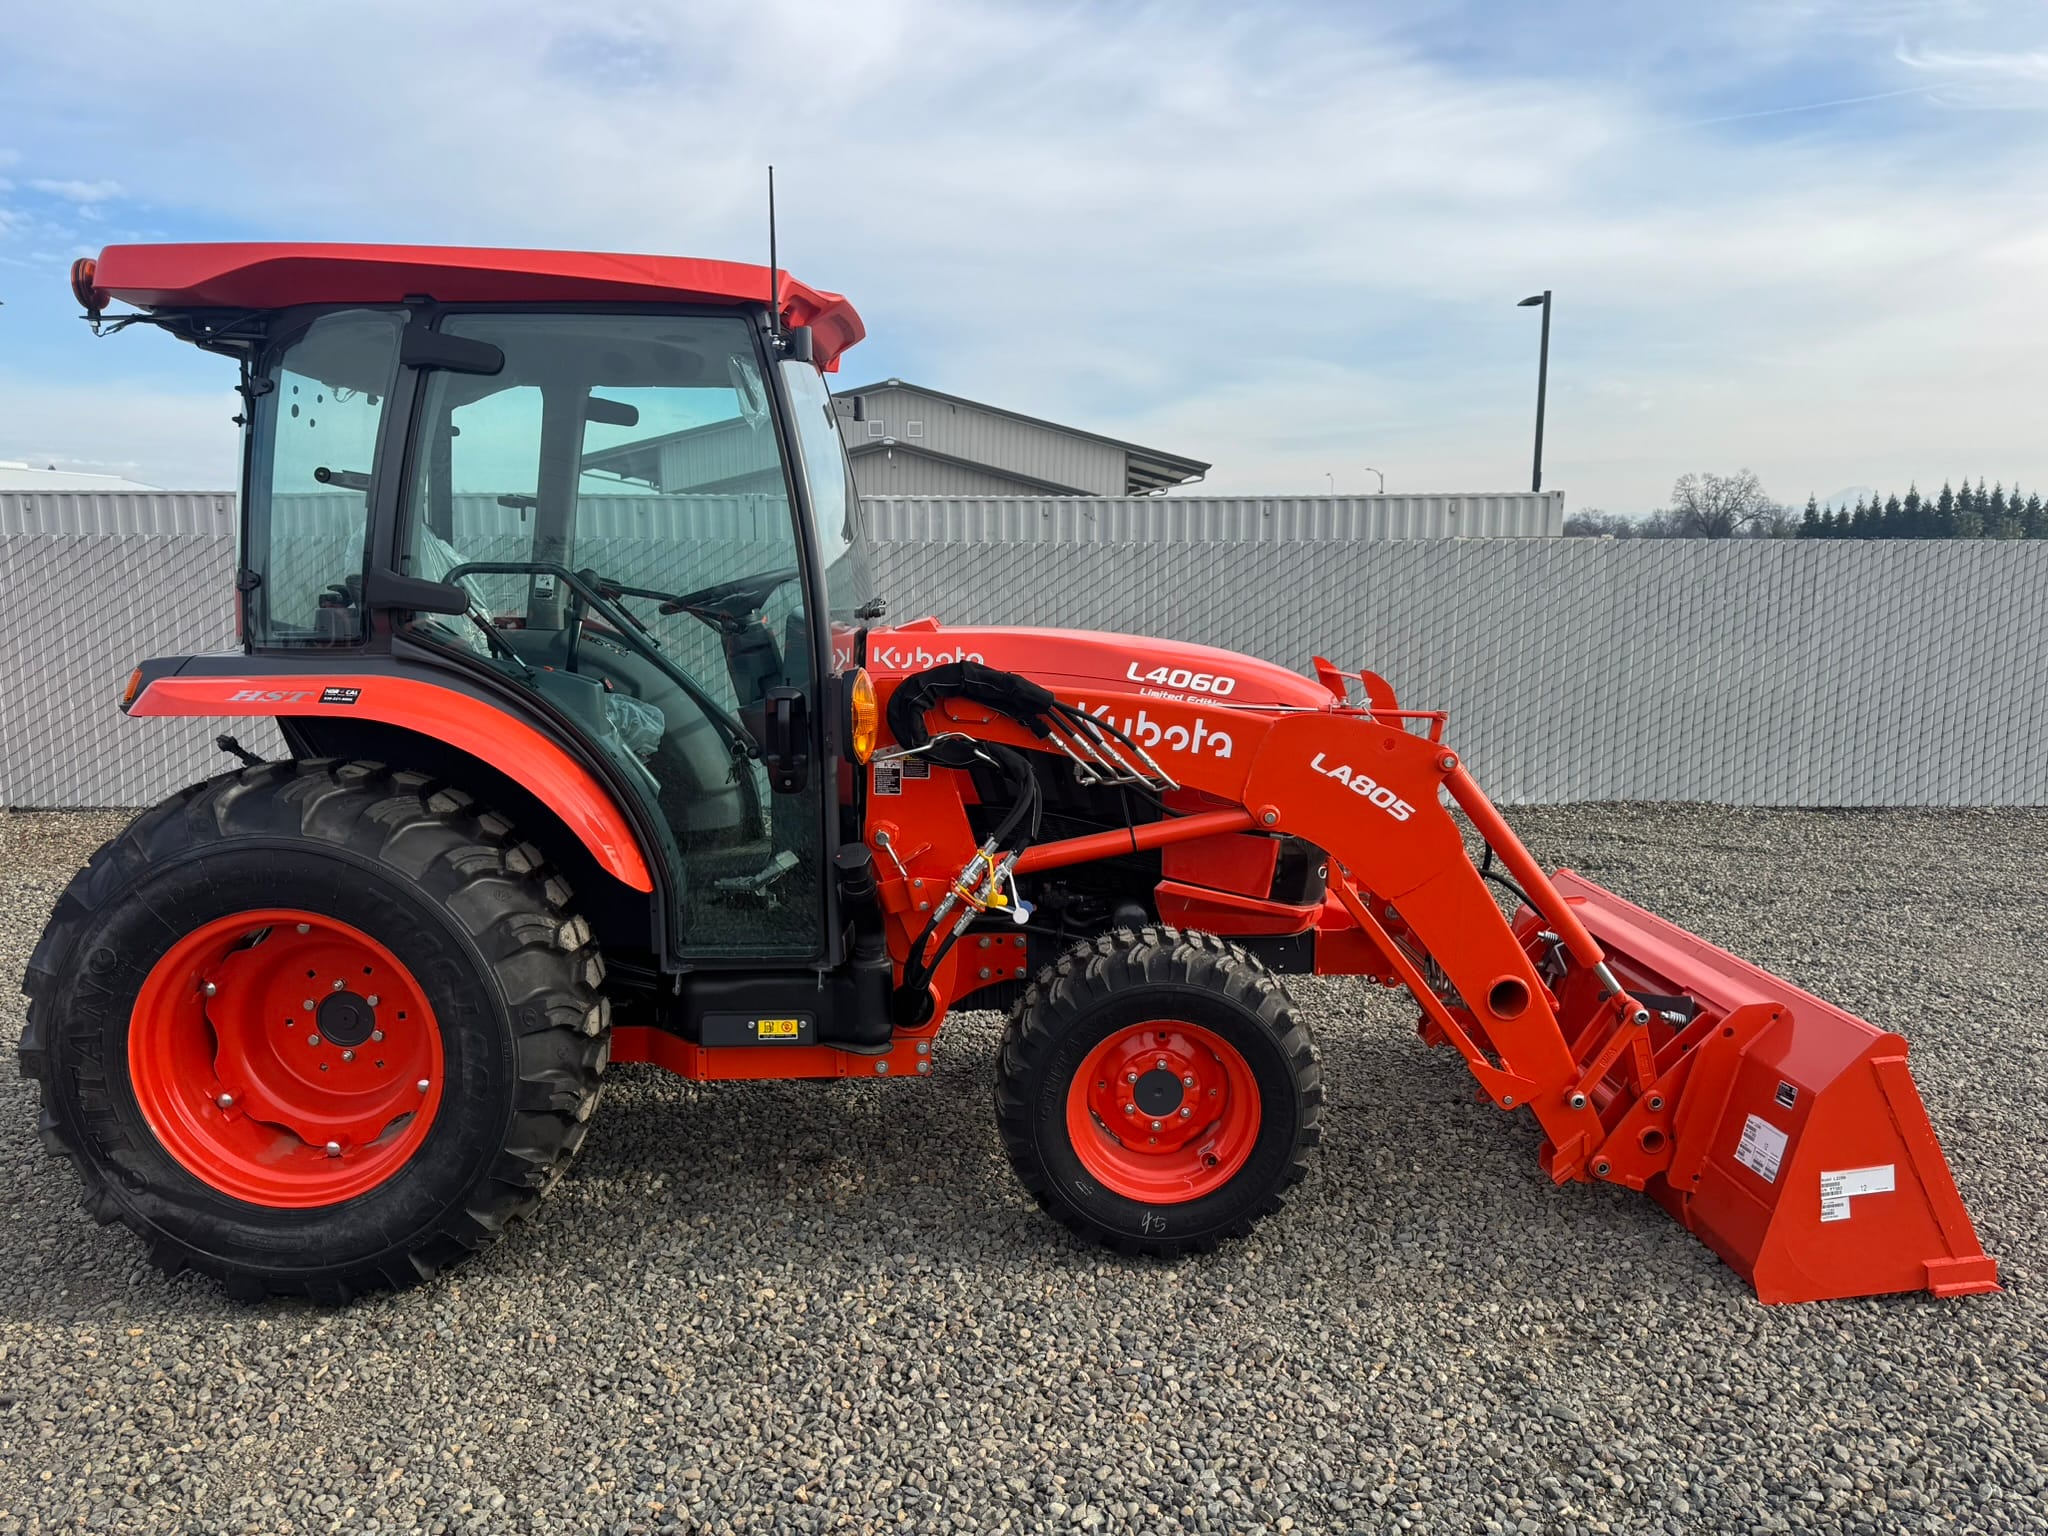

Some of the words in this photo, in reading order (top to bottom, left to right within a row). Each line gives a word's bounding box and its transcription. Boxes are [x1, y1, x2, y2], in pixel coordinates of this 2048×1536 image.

[873, 646, 984, 669] Kubota
[1126, 661, 1236, 696] L4060
[225, 689, 317, 703] HST
[1140, 687, 1184, 702] Limited
[1077, 702, 1233, 758] Kubota
[1310, 752, 1416, 821] LA805
